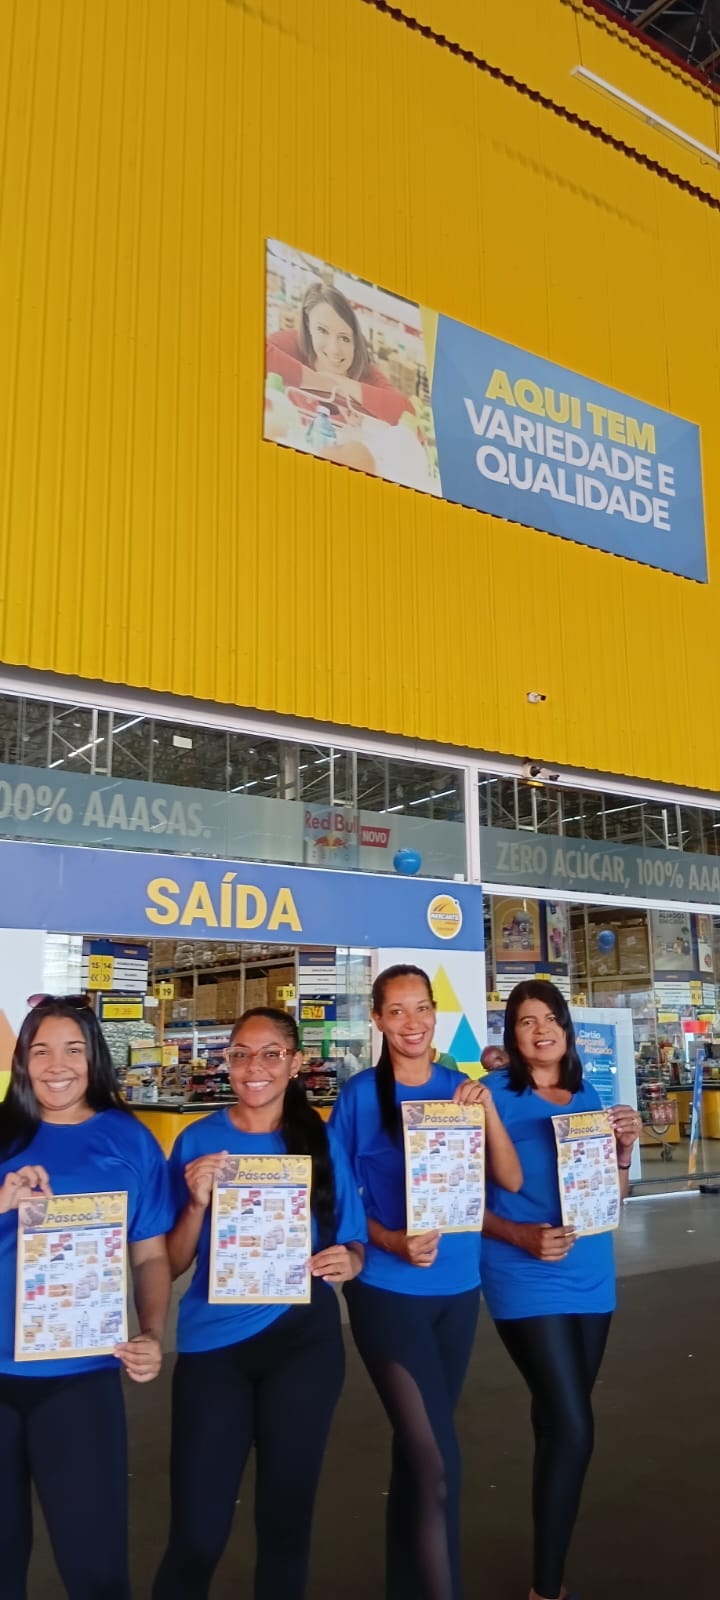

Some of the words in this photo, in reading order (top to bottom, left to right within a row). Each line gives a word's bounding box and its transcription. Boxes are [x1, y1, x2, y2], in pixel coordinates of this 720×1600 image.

[485, 368, 581, 429] AQUI
[586, 402, 656, 454] TEM
[463, 397, 653, 490] VARIEDADE
[657, 463, 675, 496] E
[475, 444, 671, 531] QUALIDADE
[82, 790, 211, 839] AAASAS.
[304, 810, 331, 830] Red
[334, 813, 359, 833] Bull
[362, 829, 387, 844] NOVO
[496, 841, 547, 875] ZERO
[552, 844, 630, 888] AÇÚCAR,
[636, 857, 684, 888] 100%
[144, 872, 303, 932] SAÍDA
